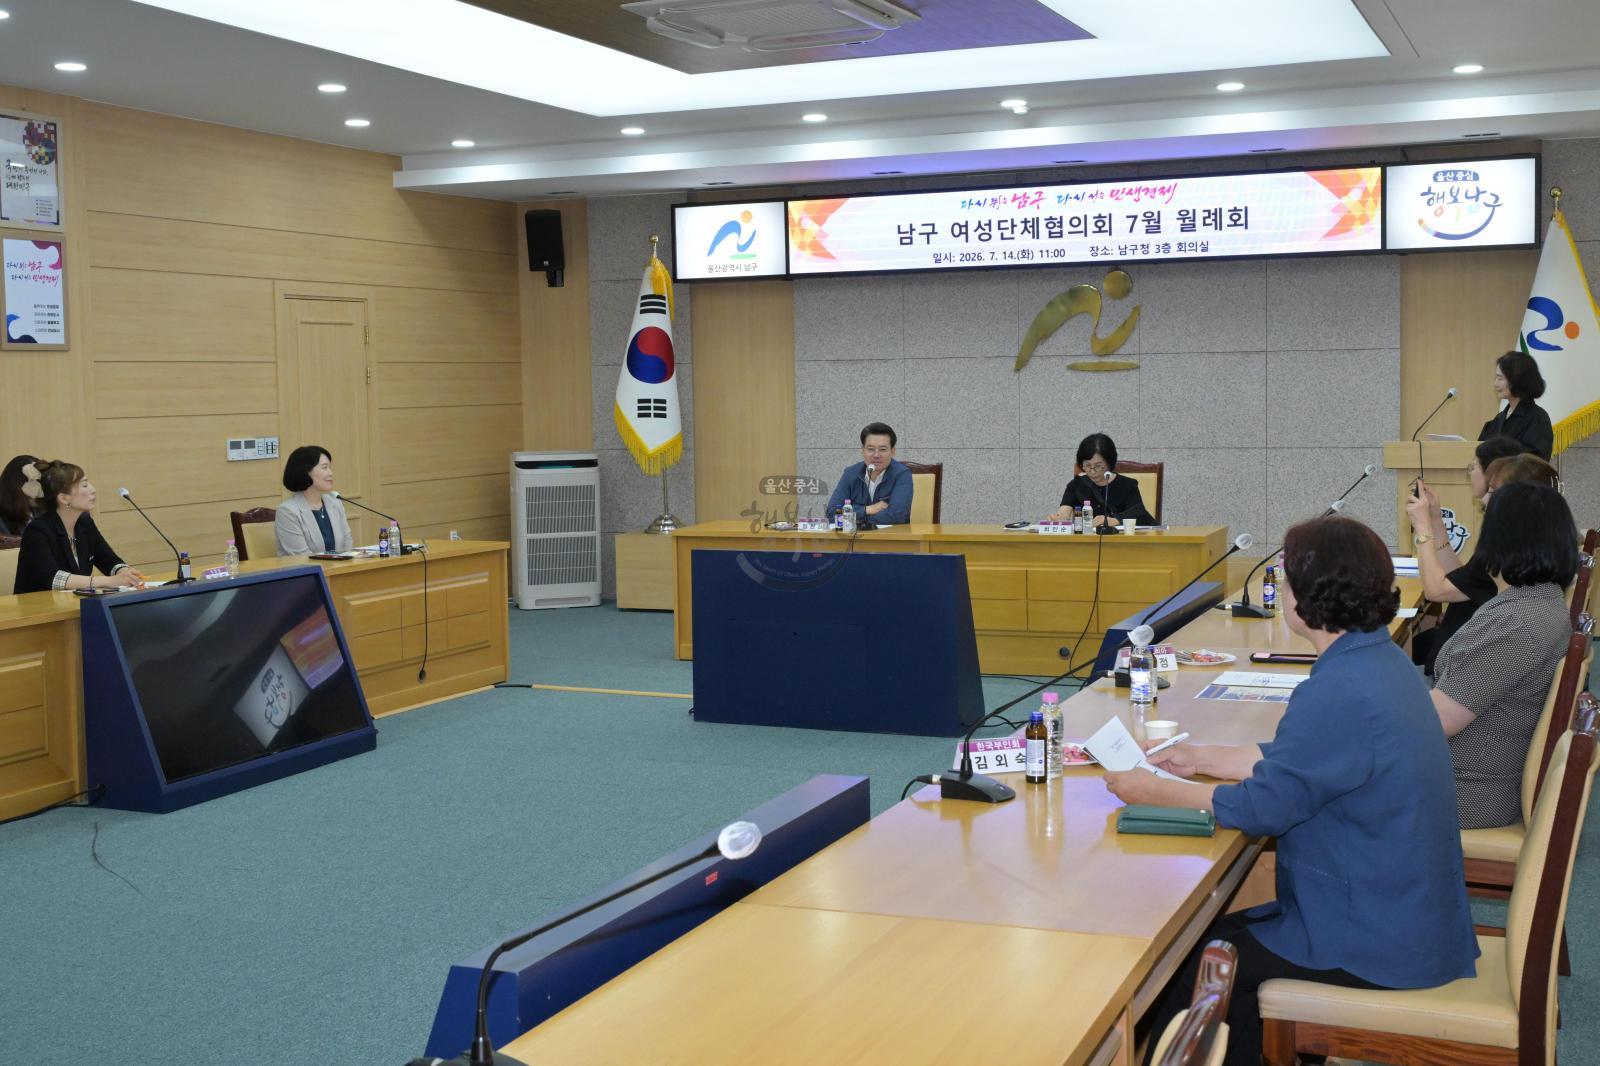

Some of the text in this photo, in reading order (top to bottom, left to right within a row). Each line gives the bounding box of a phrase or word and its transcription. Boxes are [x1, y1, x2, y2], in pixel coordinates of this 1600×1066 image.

[1436, 170, 1474, 181] 울산중심
[961, 198, 988, 210] 다시
[1011, 191, 1047, 210] 남구
[1057, 192, 1085, 204] 다시
[1109, 183, 1177, 204] 민생경제
[897, 206, 1248, 246] 남구 여성단체협의회 7월 월례회
[933, 241, 1210, 264] 일시: 2026. 7. 14.(화) 11:00 장소: 남구청 3층 회의실
[708, 262, 758, 273] 울산광역시 남구
[976, 739, 1020, 751] 한국부인회
